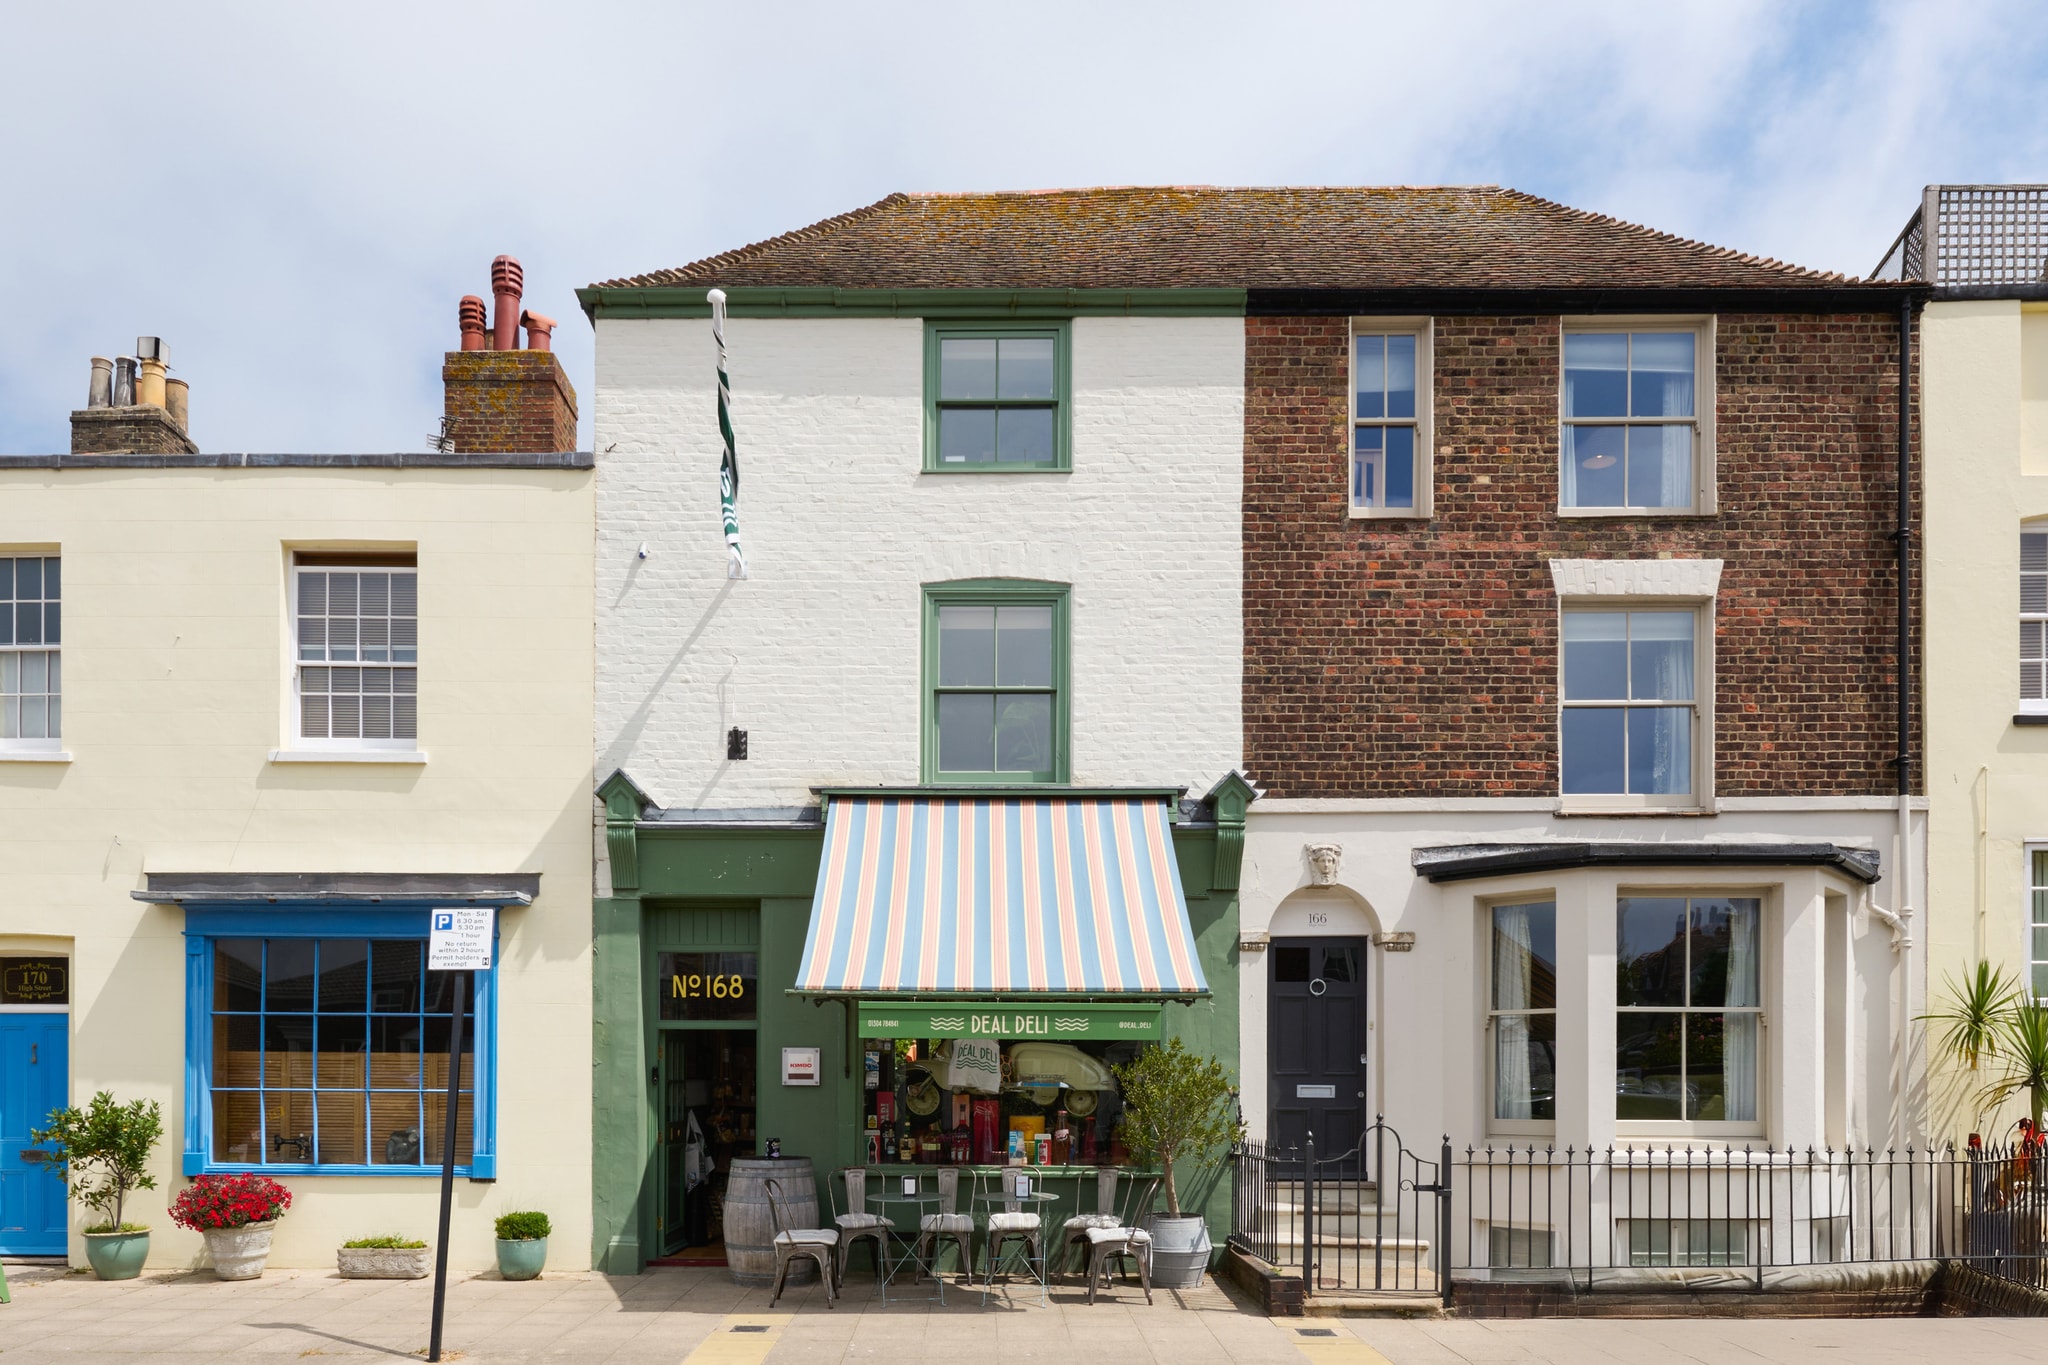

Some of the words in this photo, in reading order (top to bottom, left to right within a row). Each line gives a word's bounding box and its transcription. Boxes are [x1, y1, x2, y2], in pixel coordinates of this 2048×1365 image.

[438, 915, 449, 928] P
[1308, 913, 1327, 924] 166
[23, 971, 48, 984] 170
[706, 974, 744, 998] 168
[971, 1015, 1010, 1034] DEAL
[1015, 1015, 1048, 1034] DELI
[958, 1044, 977, 1059] DEAL
[980, 1047, 997, 1063] DELI
